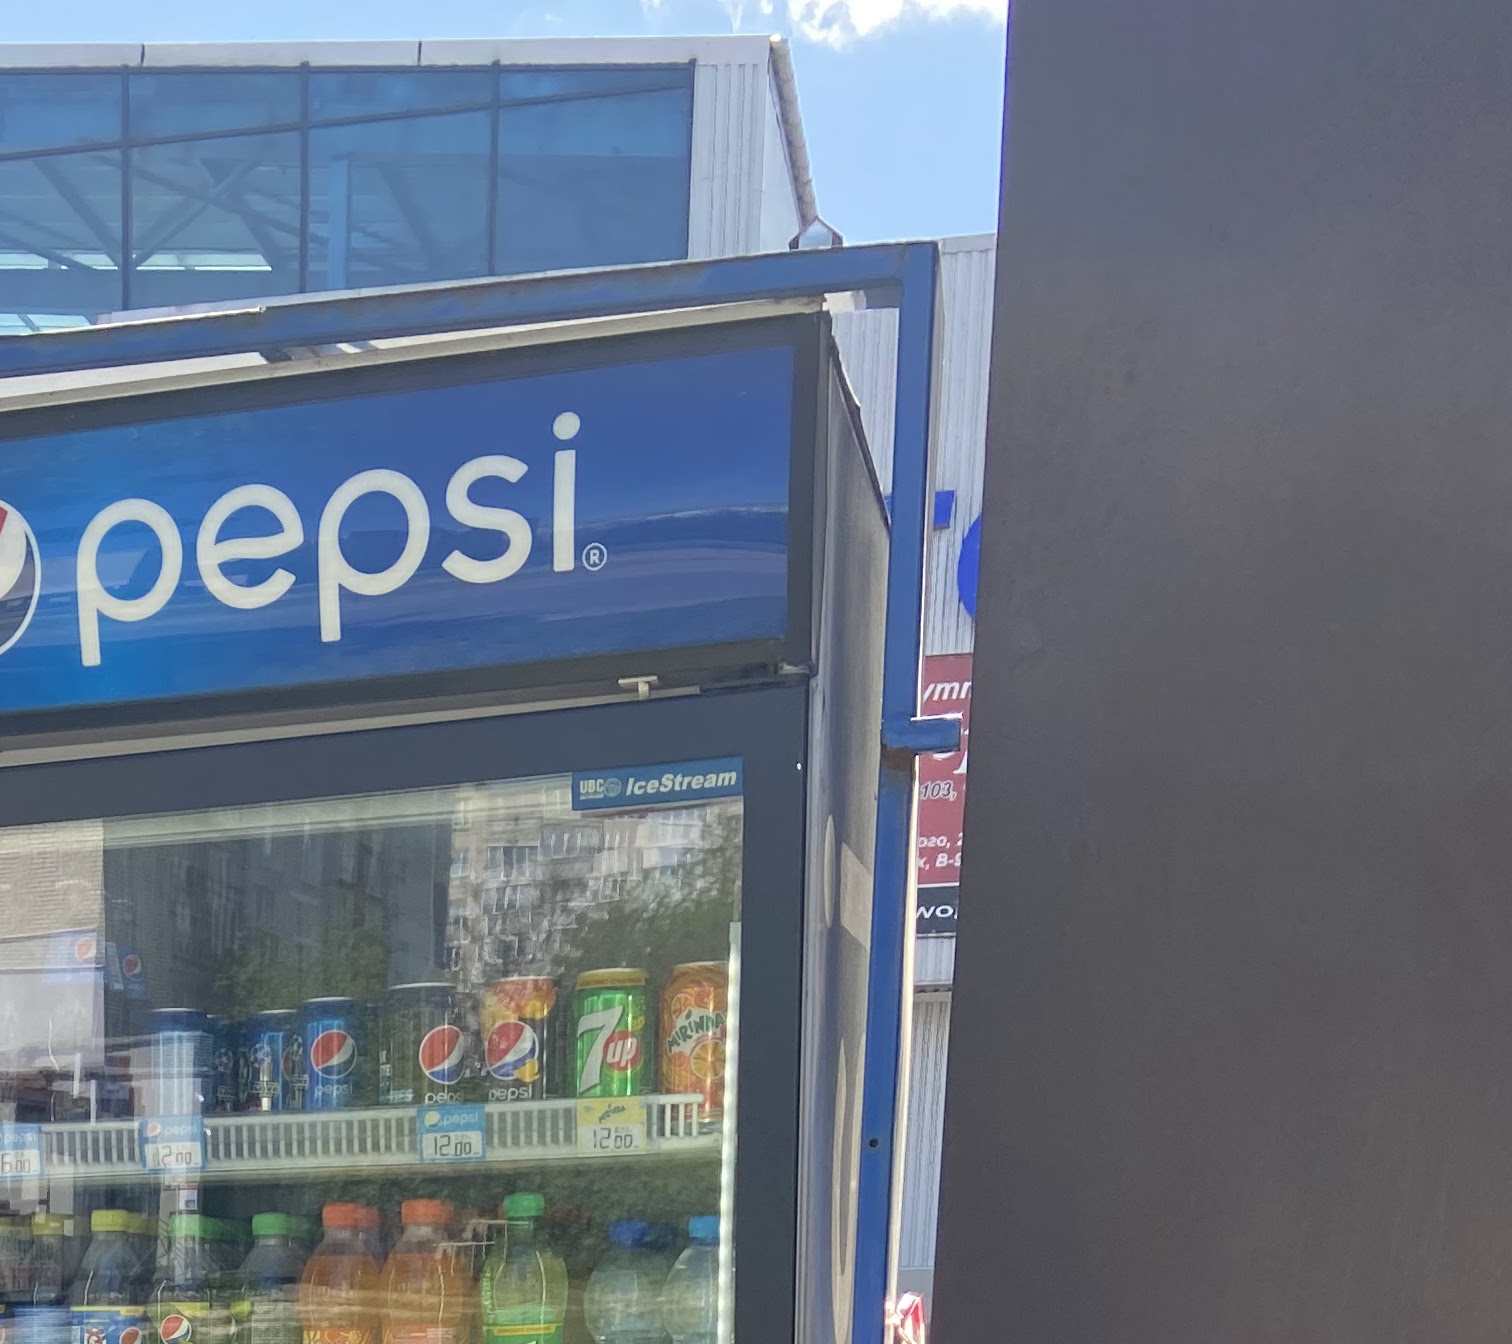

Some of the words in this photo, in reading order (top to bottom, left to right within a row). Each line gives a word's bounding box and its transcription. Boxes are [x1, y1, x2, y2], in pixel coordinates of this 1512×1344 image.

[76, 411, 578, 667] pepsi
[579, 779, 604, 794] UBC
[626, 771, 737, 796] IceStream
[488, 1086, 532, 1102] pepsi
